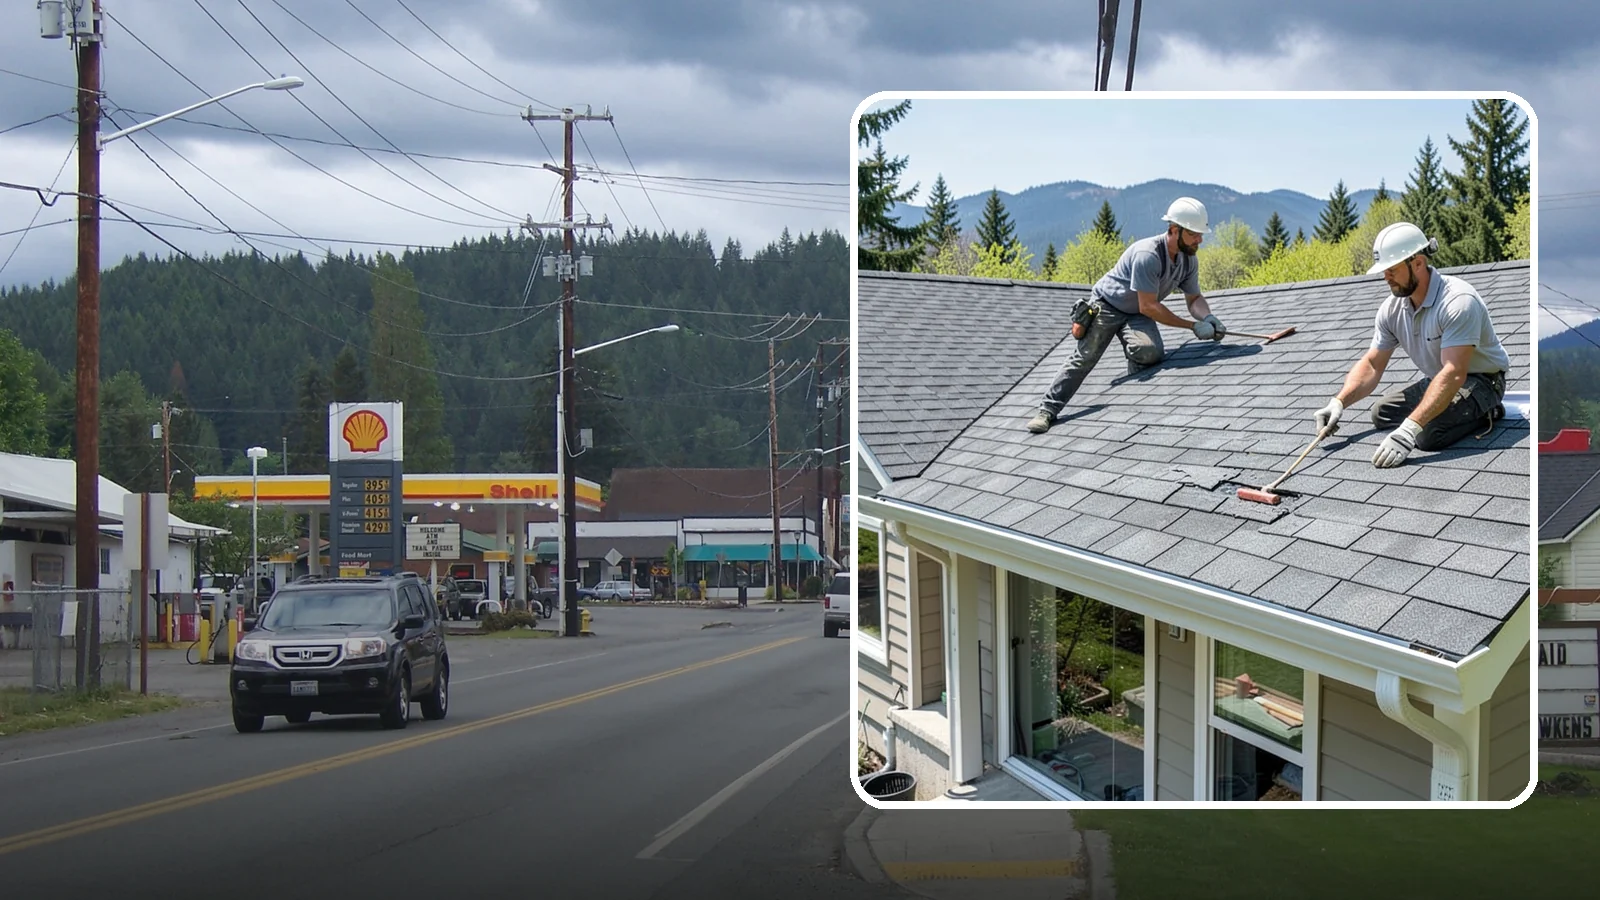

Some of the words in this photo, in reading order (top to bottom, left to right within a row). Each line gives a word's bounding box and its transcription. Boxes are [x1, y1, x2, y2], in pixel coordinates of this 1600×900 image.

[365, 480, 384, 490] 395
[490, 484, 547, 499] Shell
[365, 494, 384, 504] 405
[365, 508, 384, 518] 415
[365, 522, 384, 532] 429
